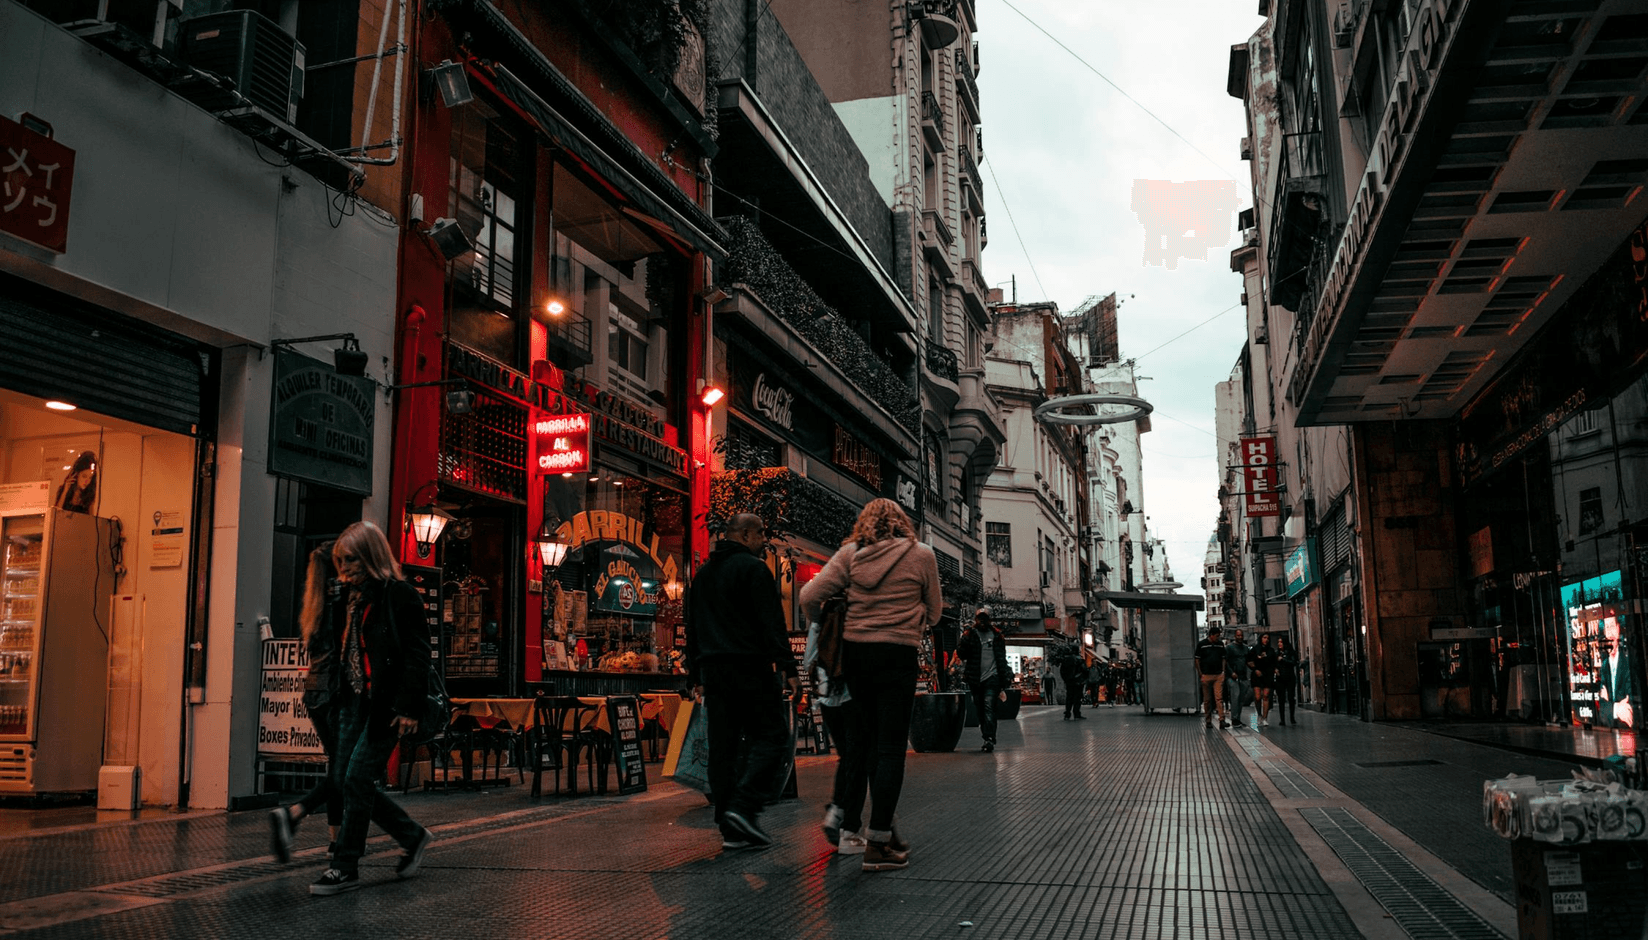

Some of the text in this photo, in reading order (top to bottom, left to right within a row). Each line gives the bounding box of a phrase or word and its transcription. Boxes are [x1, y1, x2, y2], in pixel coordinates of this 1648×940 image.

[1377, 101, 1400, 184] DE
[1396, 49, 1429, 134] LA
[1418, 0, 1452, 71] GR
[277, 371, 372, 429] ALQUILER TEMPORARIO
[322, 402, 334, 423] DE
[752, 372, 795, 433] Coca-Cola
[295, 417, 366, 457] MINI OFICINAS
[536, 416, 586, 434] PARRILLA
[553, 437, 570, 450] AL
[539, 451, 581, 469] CARBON
[1248, 442, 1270, 504] HOTEL
[555, 510, 678, 583] PARRILLA
[607, 560, 647, 605] GAUCHO
[262, 672, 294, 692] Ambiente
[261, 698, 290, 717] Mayor
[259, 726, 319, 748] Boxes Privados
